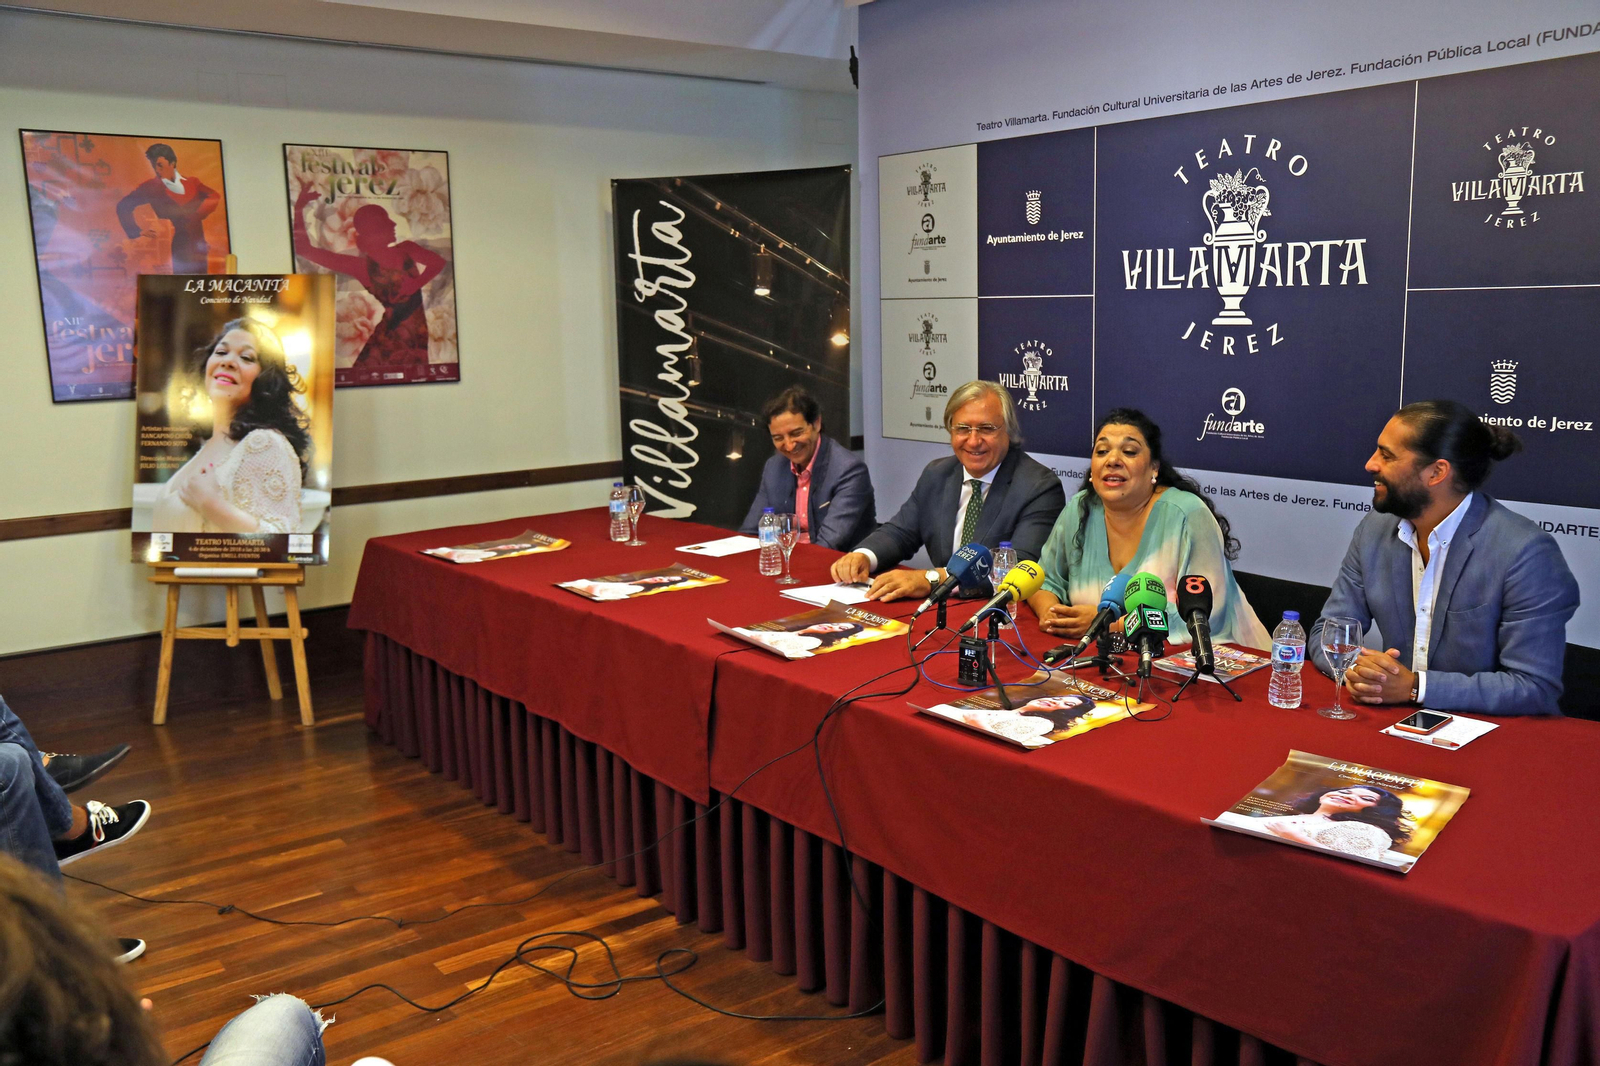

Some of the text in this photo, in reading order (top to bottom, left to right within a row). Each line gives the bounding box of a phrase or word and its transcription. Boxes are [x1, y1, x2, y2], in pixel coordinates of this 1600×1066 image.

[976, 21, 1600, 132] Teatro Villamarta. Fundación Cultural Universitaria de las Artes de Jerez. Fundación Pública Local (FUNDA
[1483, 126, 1556, 151] TEATRO
[301, 152, 377, 175] festival
[1174, 134, 1308, 185] TEATRO
[324, 176, 401, 204] jerez
[906, 182, 947, 196] VILLAMARTA
[1452, 171, 1585, 202] VILLAMARTA
[1484, 210, 1541, 229] JEREZ
[907, 233, 947, 255] fundarte
[986, 229, 1084, 246] Ayuntamiento de Jerez
[1121, 239, 1369, 290] VILLAMARTA
[184, 278, 290, 294] LA MACANITA
[200, 295, 273, 305] Concierto de Navidad
[52, 320, 134, 341] festiva
[908, 333, 948, 344] VILLAMARTA
[1181, 321, 1284, 356] JEREZ
[1014, 339, 1053, 356] TEATRO
[81, 343, 136, 375] jer
[910, 379, 948, 400] fundarte
[999, 372, 1069, 391] VILLAMARTA
[1018, 398, 1048, 411] JEREZ
[1196, 413, 1265, 441] fundarte
[1477, 413, 1594, 432] iento de Jerez
[1051, 467, 1087, 479] Fundaci
[1203, 485, 1217, 495] de
[1220, 486, 1237, 497] las
[1239, 488, 1270, 501] Artes
[1273, 492, 1288, 503] de
[1291, 494, 1329, 508] Jerez.
[1333, 498, 1374, 513] Funda
[1538, 520, 1600, 538] DARTE
[195, 538, 265, 546] TEATRO VILLAMARTA
[961, 545, 978, 556] ONDA
[955, 551, 974, 562] JEREZ
[1327, 761, 1426, 789] LA MACANITA
